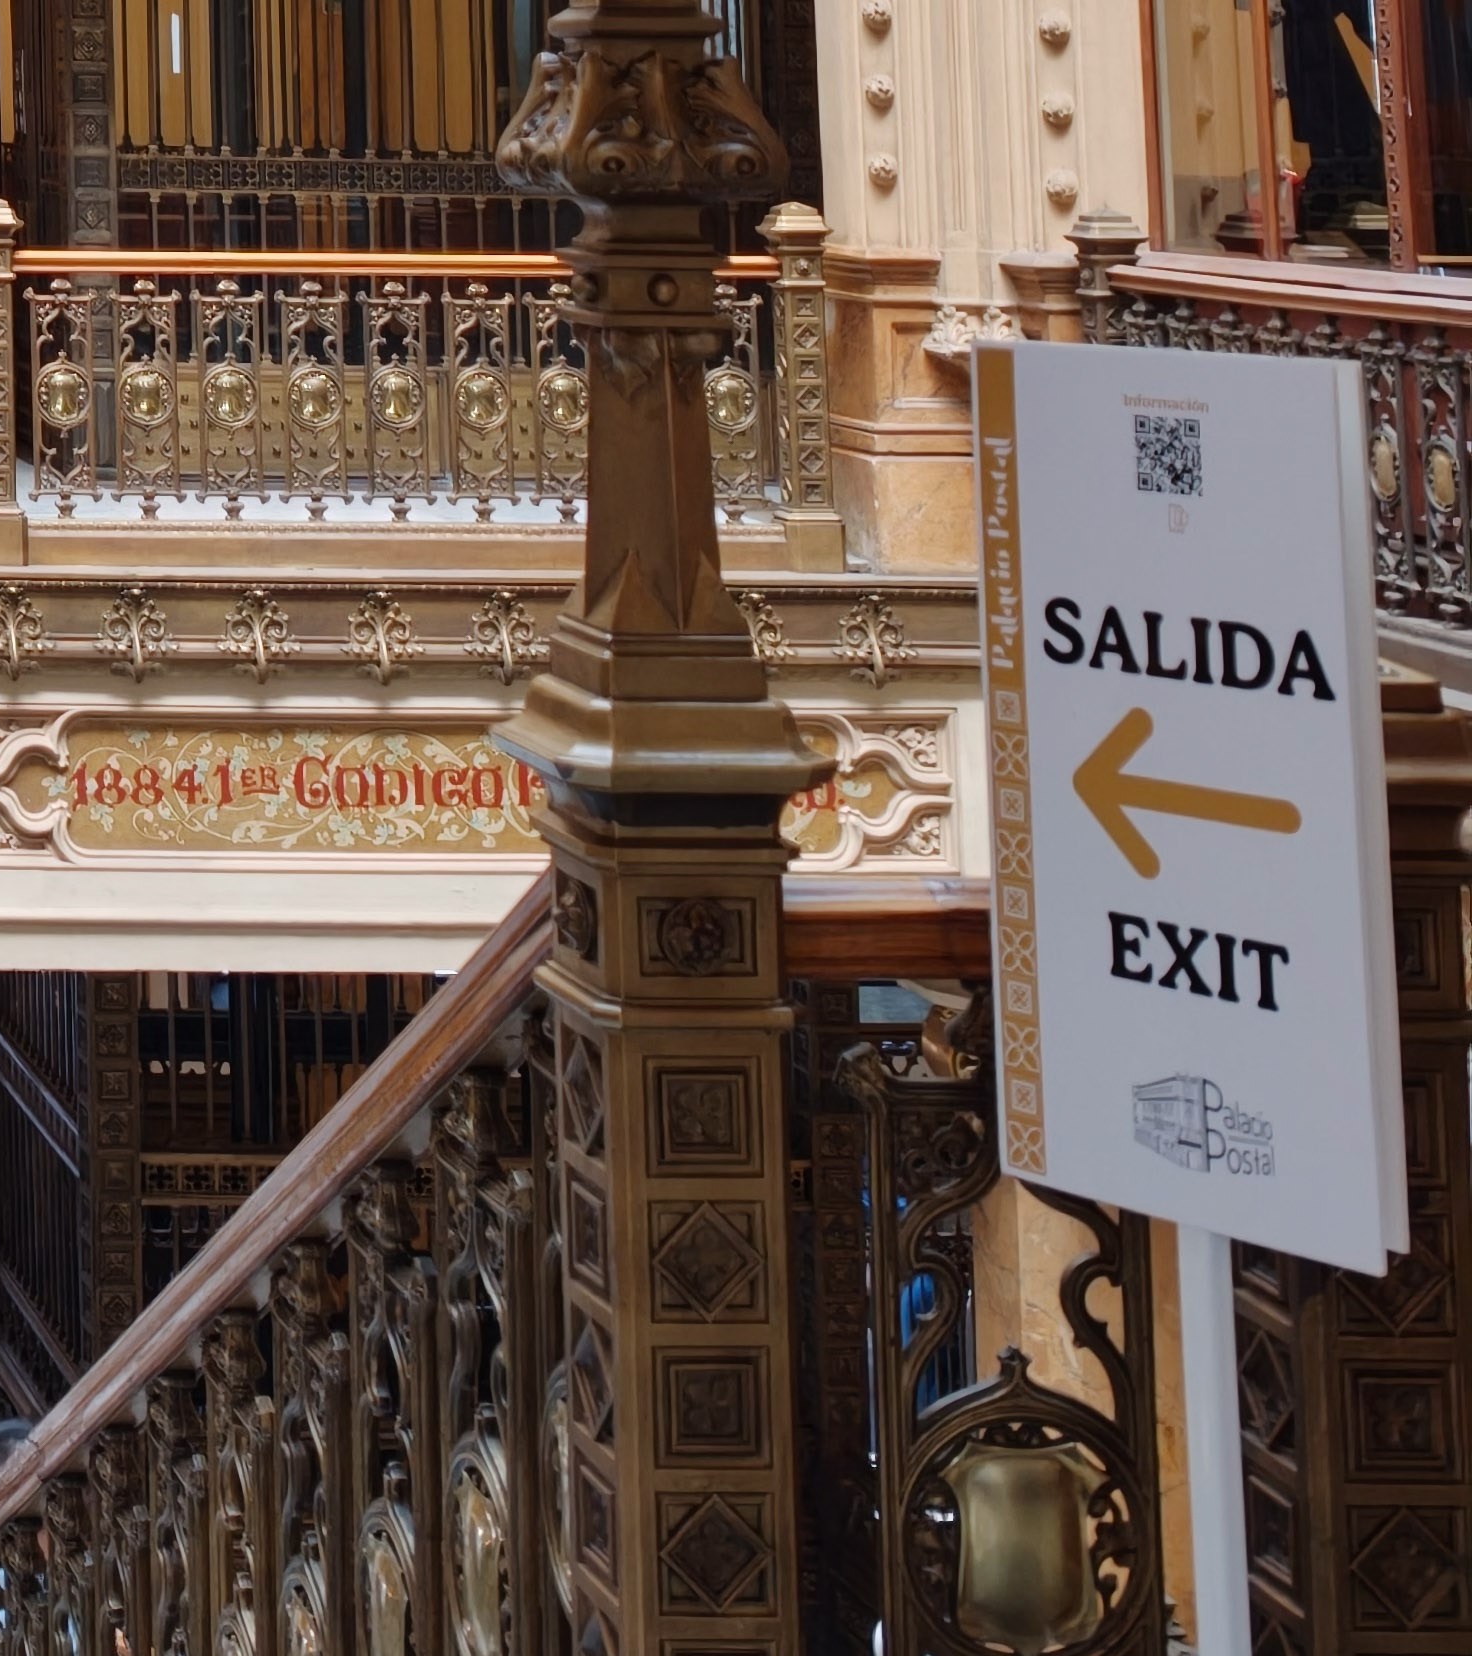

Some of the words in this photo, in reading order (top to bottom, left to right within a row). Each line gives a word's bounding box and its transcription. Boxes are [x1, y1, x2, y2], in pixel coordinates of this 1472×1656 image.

[984, 436, 1014, 539] Postal
[1043, 597, 1336, 701] SALIDA
[1108, 911, 1290, 1012] EXIT
[1202, 1078, 1274, 1140] Palacio
[1205, 1128, 1276, 1176] Postal
